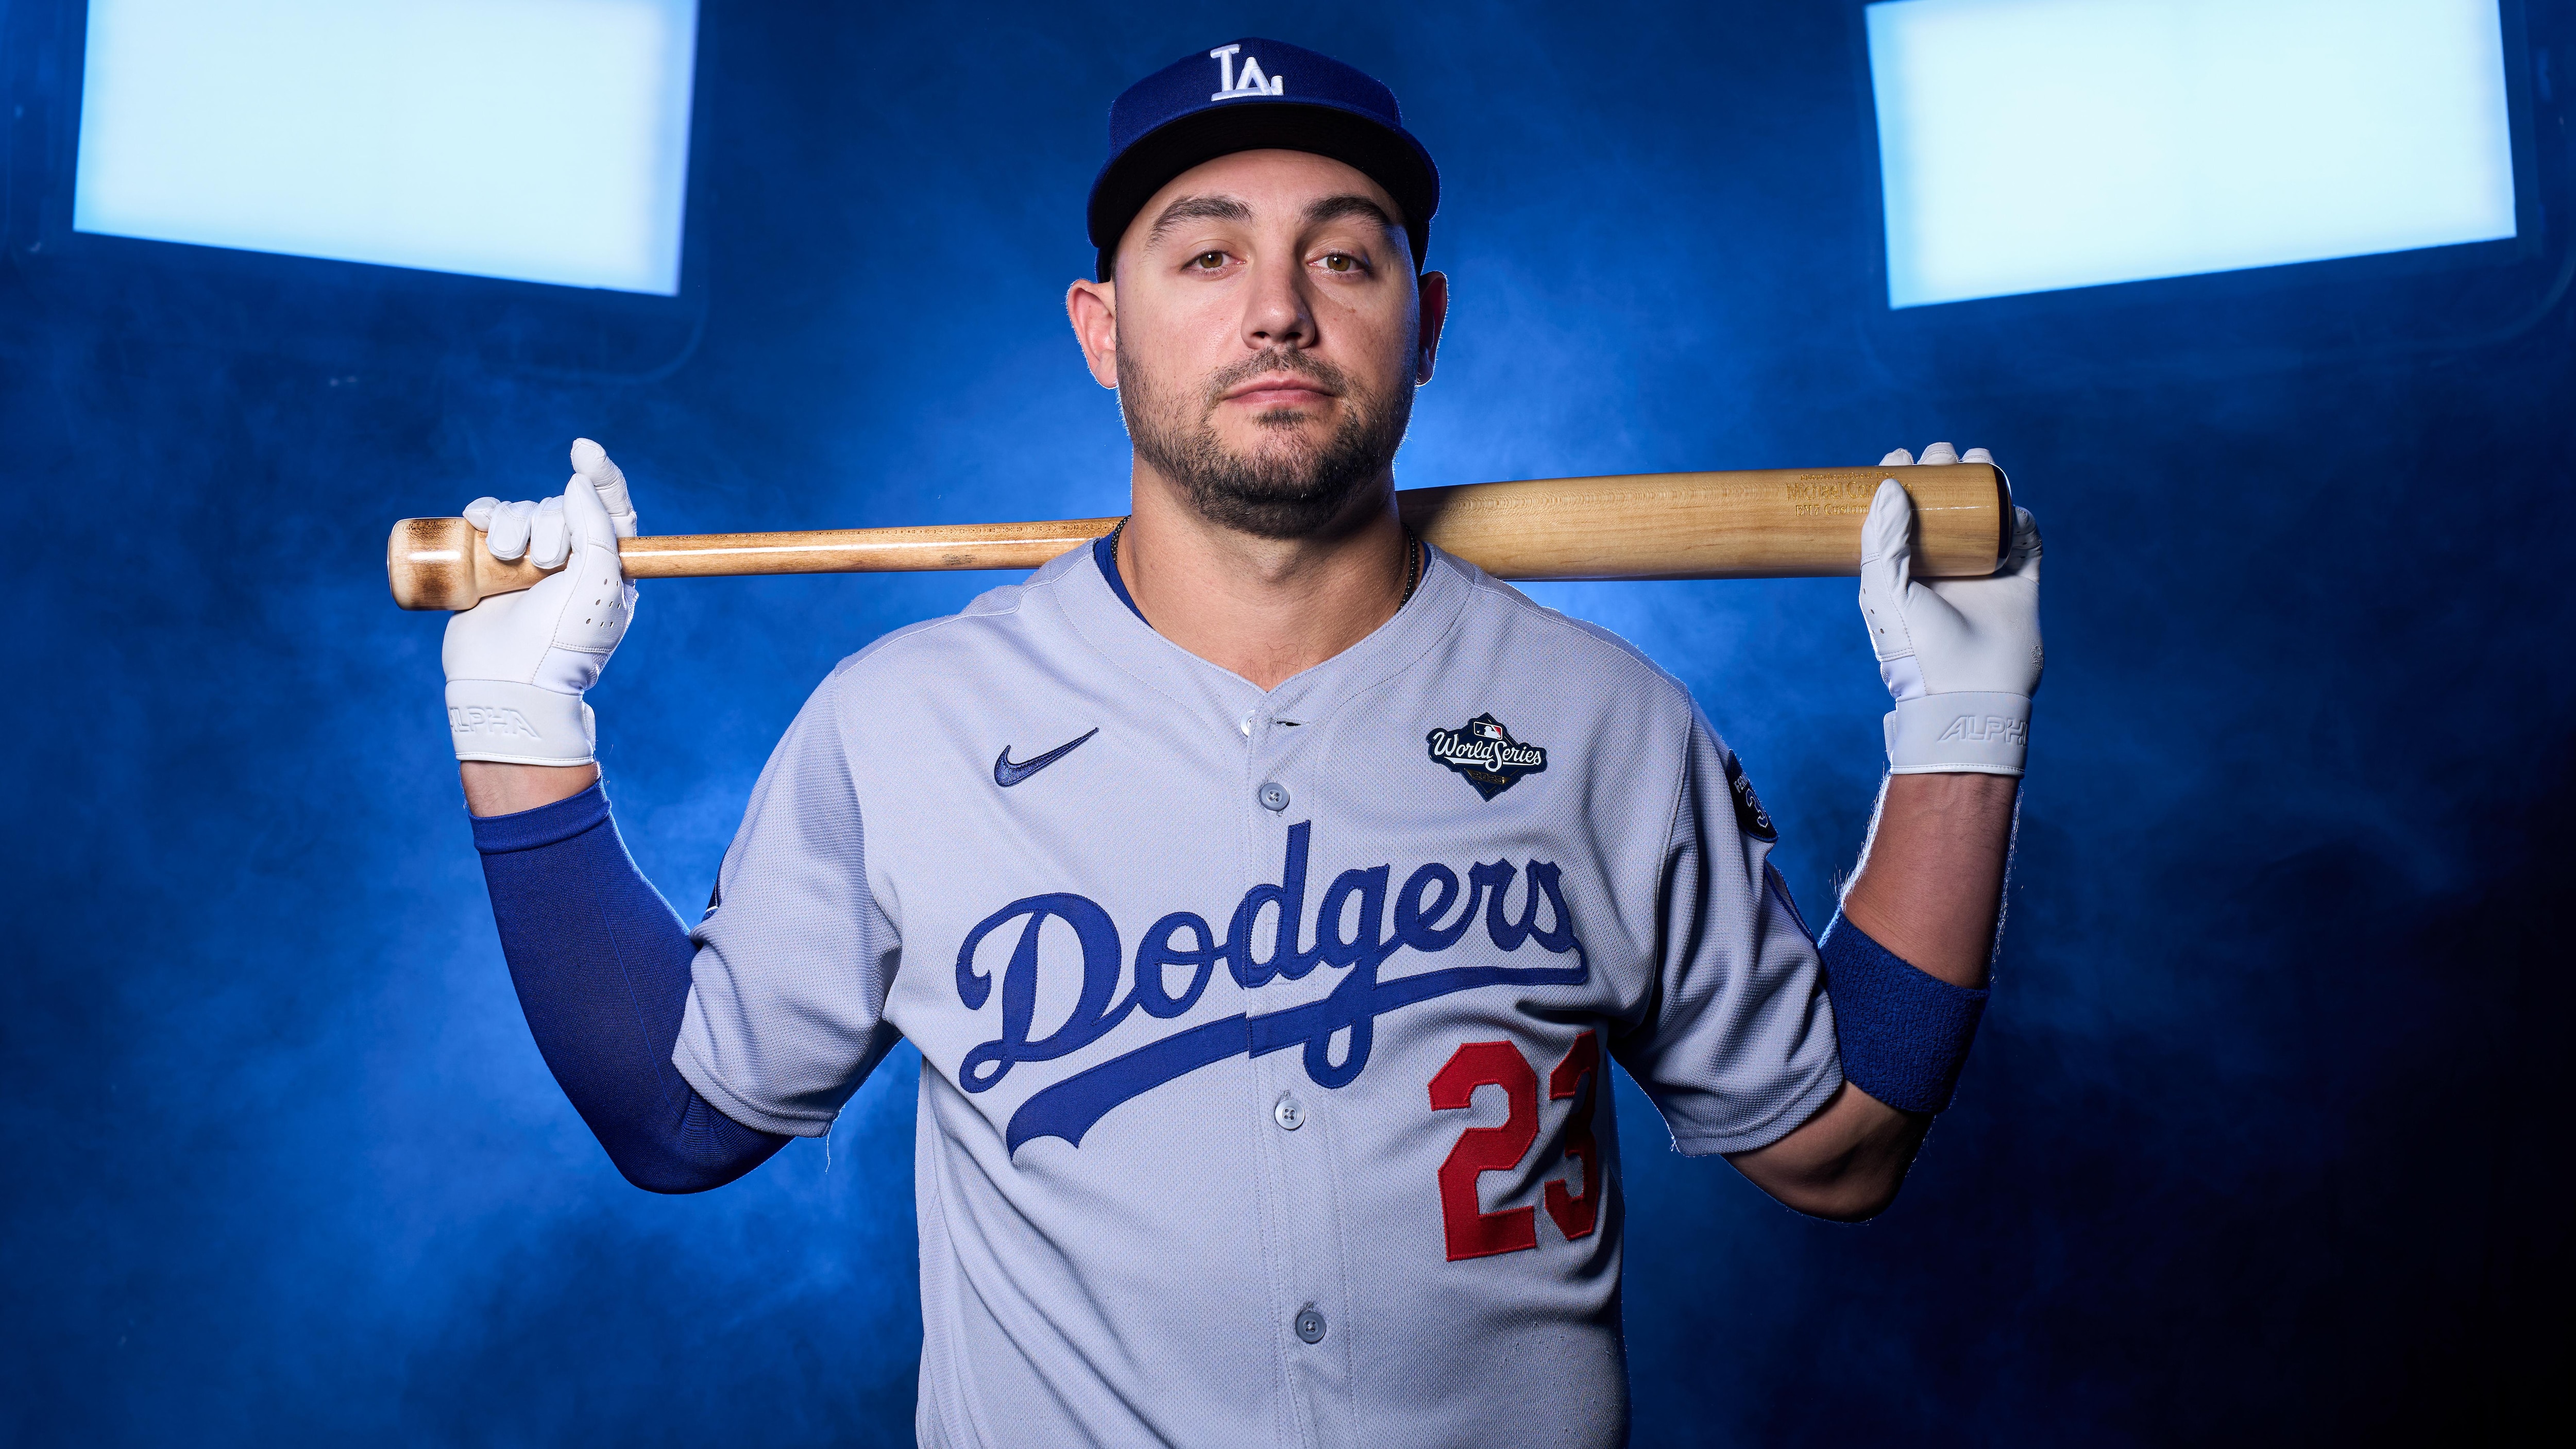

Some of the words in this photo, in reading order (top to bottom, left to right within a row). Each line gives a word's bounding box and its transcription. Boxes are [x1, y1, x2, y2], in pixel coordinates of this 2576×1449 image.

[1210, 43, 1284, 102] LA
[1800, 471, 1872, 480] Handcrafted
[1786, 482, 1843, 501] Michael
[1795, 504, 1820, 516] BM7
[1824, 503, 1868, 515] Custom
[1472, 771, 1505, 785] 2025
[956, 819, 1588, 1093] Dodgers
[1428, 1029, 1600, 1262] 23
